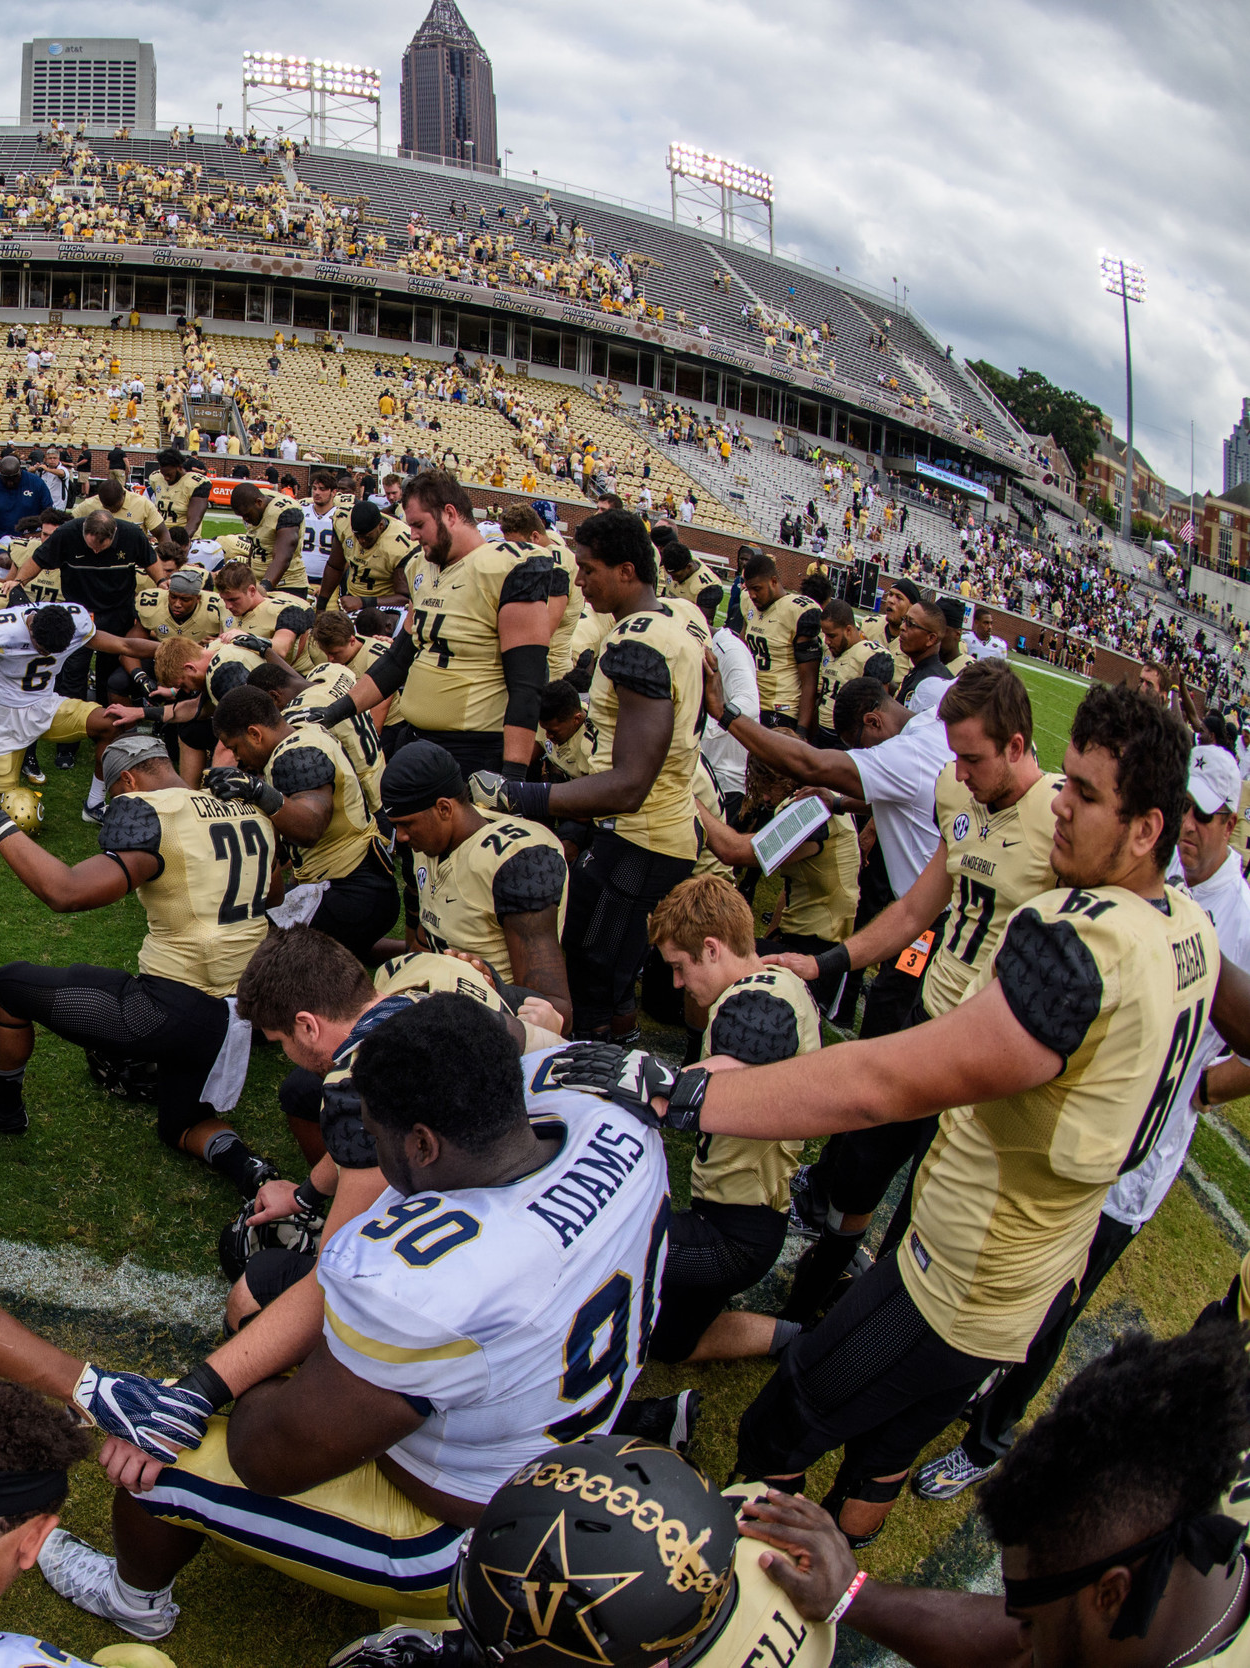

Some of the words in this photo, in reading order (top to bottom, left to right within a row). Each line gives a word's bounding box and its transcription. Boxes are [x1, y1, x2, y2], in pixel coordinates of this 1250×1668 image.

[58, 251, 124, 262] FLOWERS
[154, 256, 202, 267] GUYON
[316, 264, 340, 273] JOHN
[315, 271, 377, 287] HEISMAN
[409, 277, 444, 288] EVERETT
[408, 284, 472, 301] STRUPPER
[494, 292, 510, 300] BILL
[493, 299, 545, 316] FINCHER
[563, 307, 595, 319] WILLIAM
[561, 313, 628, 335] ALEXANDER
[709, 344, 735, 356] GEORGE
[708, 350, 755, 370] GARDNER
[771, 363, 792, 374] BOBBY
[770, 368, 797, 382] DODD
[813, 377, 832, 387] LARRY
[812, 383, 846, 400] MORRIS
[858, 399, 891, 416] GASTON
[495, 541, 537, 558] 74
[350, 561, 375, 590] 74
[698, 573, 712, 585] 41
[21, 655, 56, 692] 6
[189, 796, 257, 819] CRAWFORD
[480, 823, 532, 857] 25
[209, 819, 270, 926] 22
[960, 854, 997, 877] VANDERBILT
[947, 875, 997, 966] 17
[907, 953, 918, 967] 3
[1117, 998, 1205, 1177] 61
[526, 1123, 645, 1249] ADAMS
[360, 1196, 482, 1268] 90
